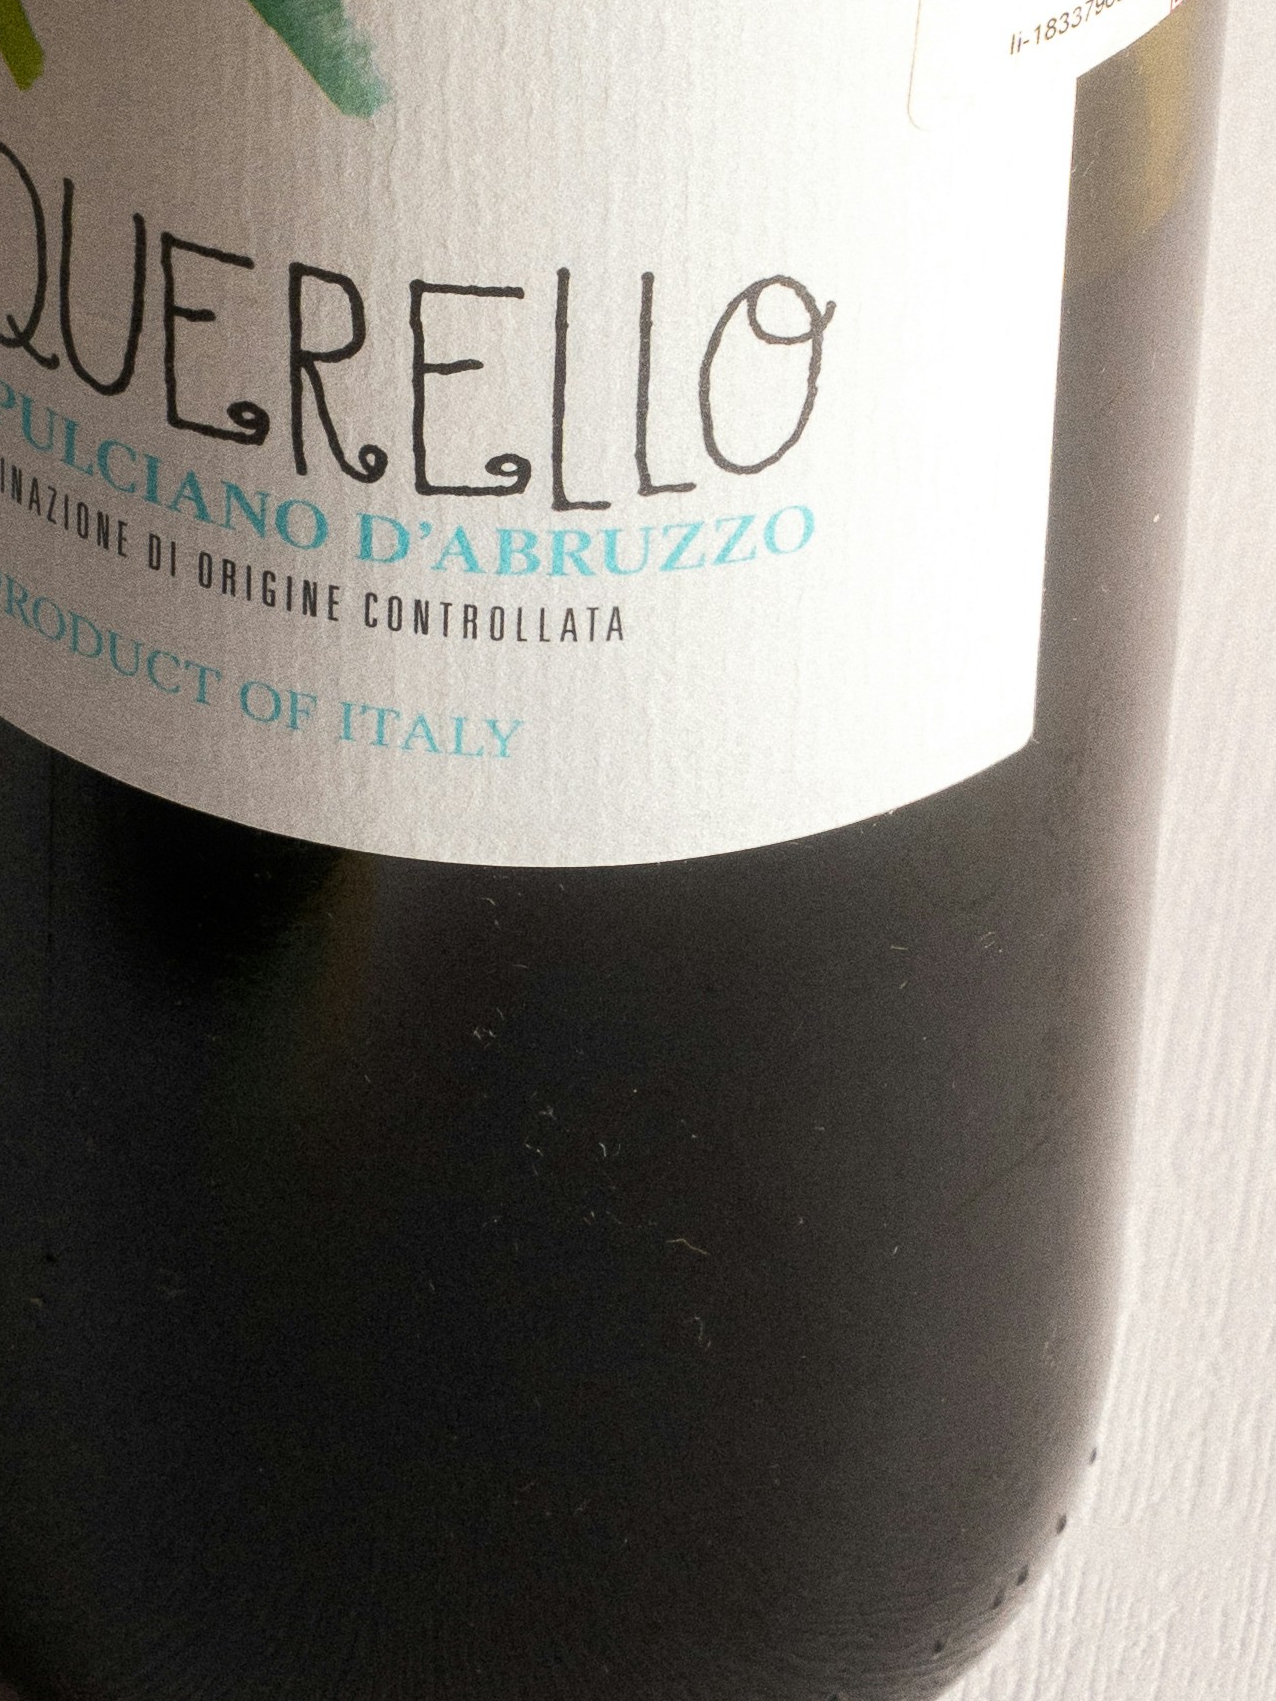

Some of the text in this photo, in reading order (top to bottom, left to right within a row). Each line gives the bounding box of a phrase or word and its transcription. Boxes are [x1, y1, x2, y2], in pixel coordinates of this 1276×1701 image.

[355, 503, 817, 578] D'ABRUZZO
[147, 533, 178, 579] DI
[198, 552, 341, 623] ORIGINE
[363, 592, 625, 643] CONTROLLATA
[238, 679, 319, 732] OF
[338, 700, 524, 759] ITALY
